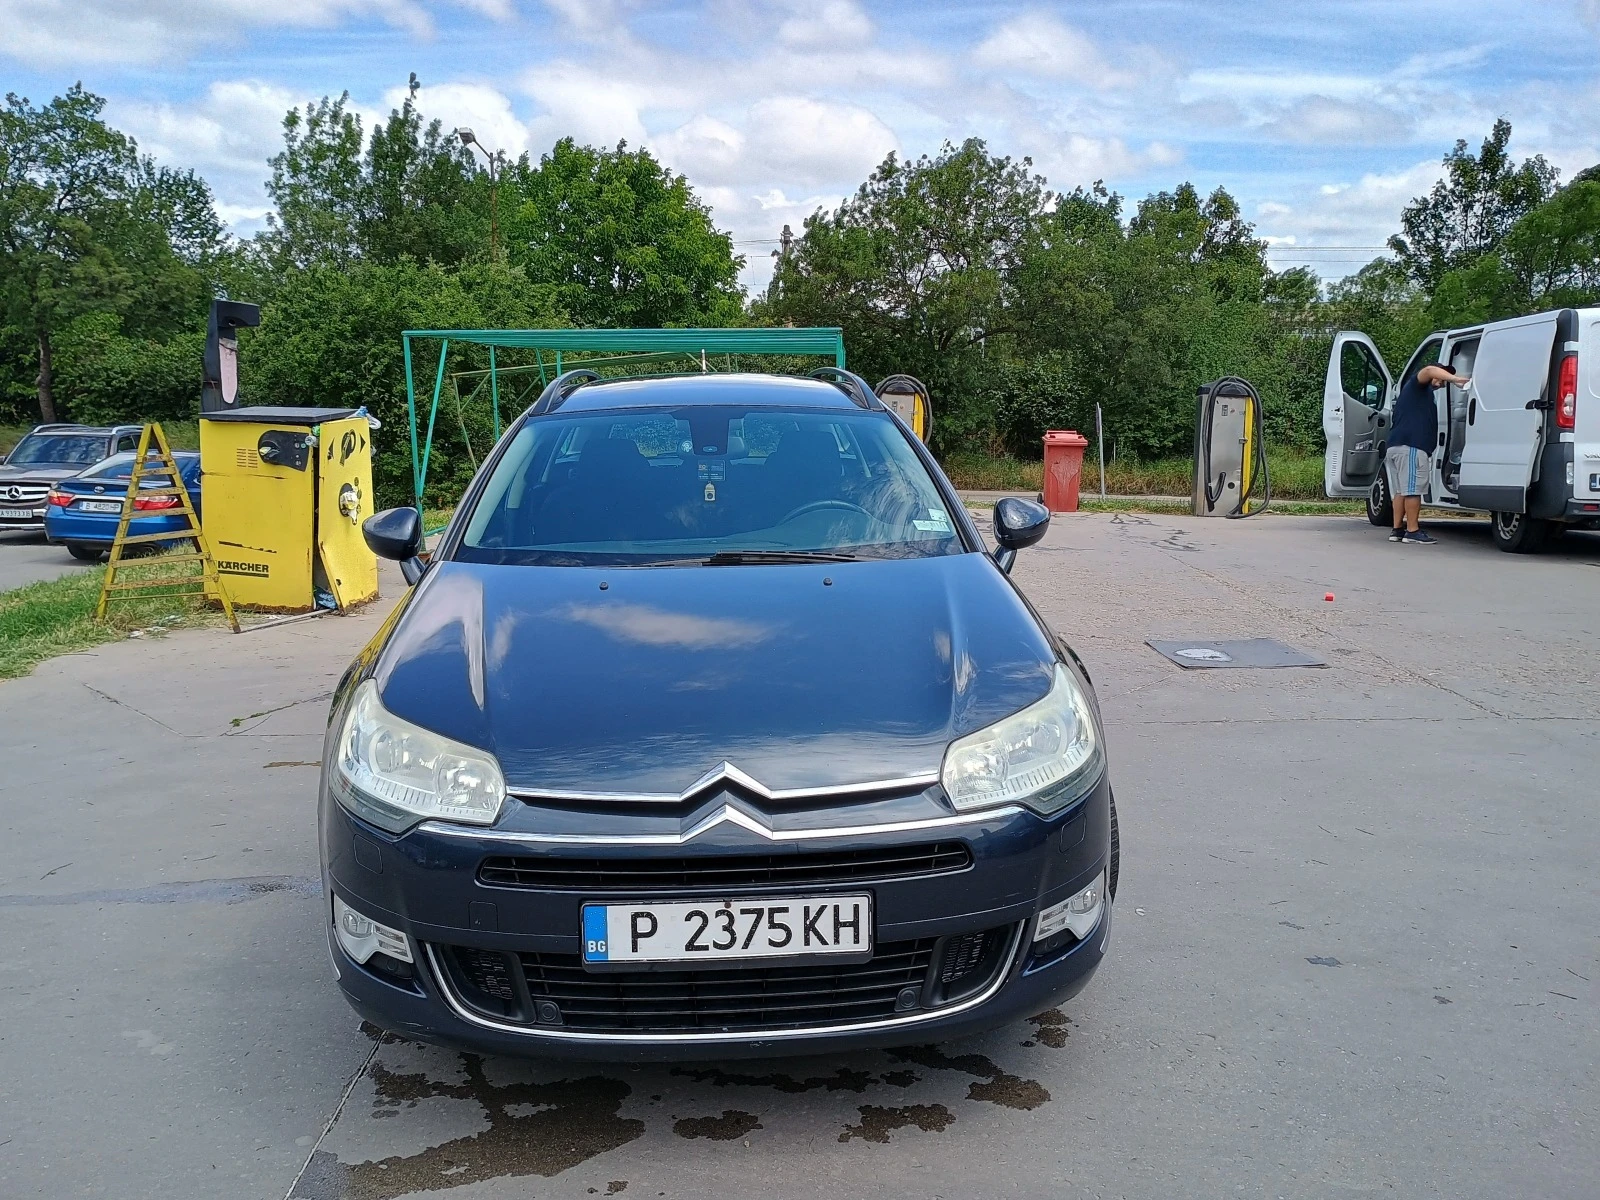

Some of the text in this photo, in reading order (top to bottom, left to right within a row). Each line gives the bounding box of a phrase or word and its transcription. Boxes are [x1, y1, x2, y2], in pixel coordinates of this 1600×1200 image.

[218, 561, 269, 573] KÄRCHER
[587, 903, 860, 953] BG P 2375 KH
